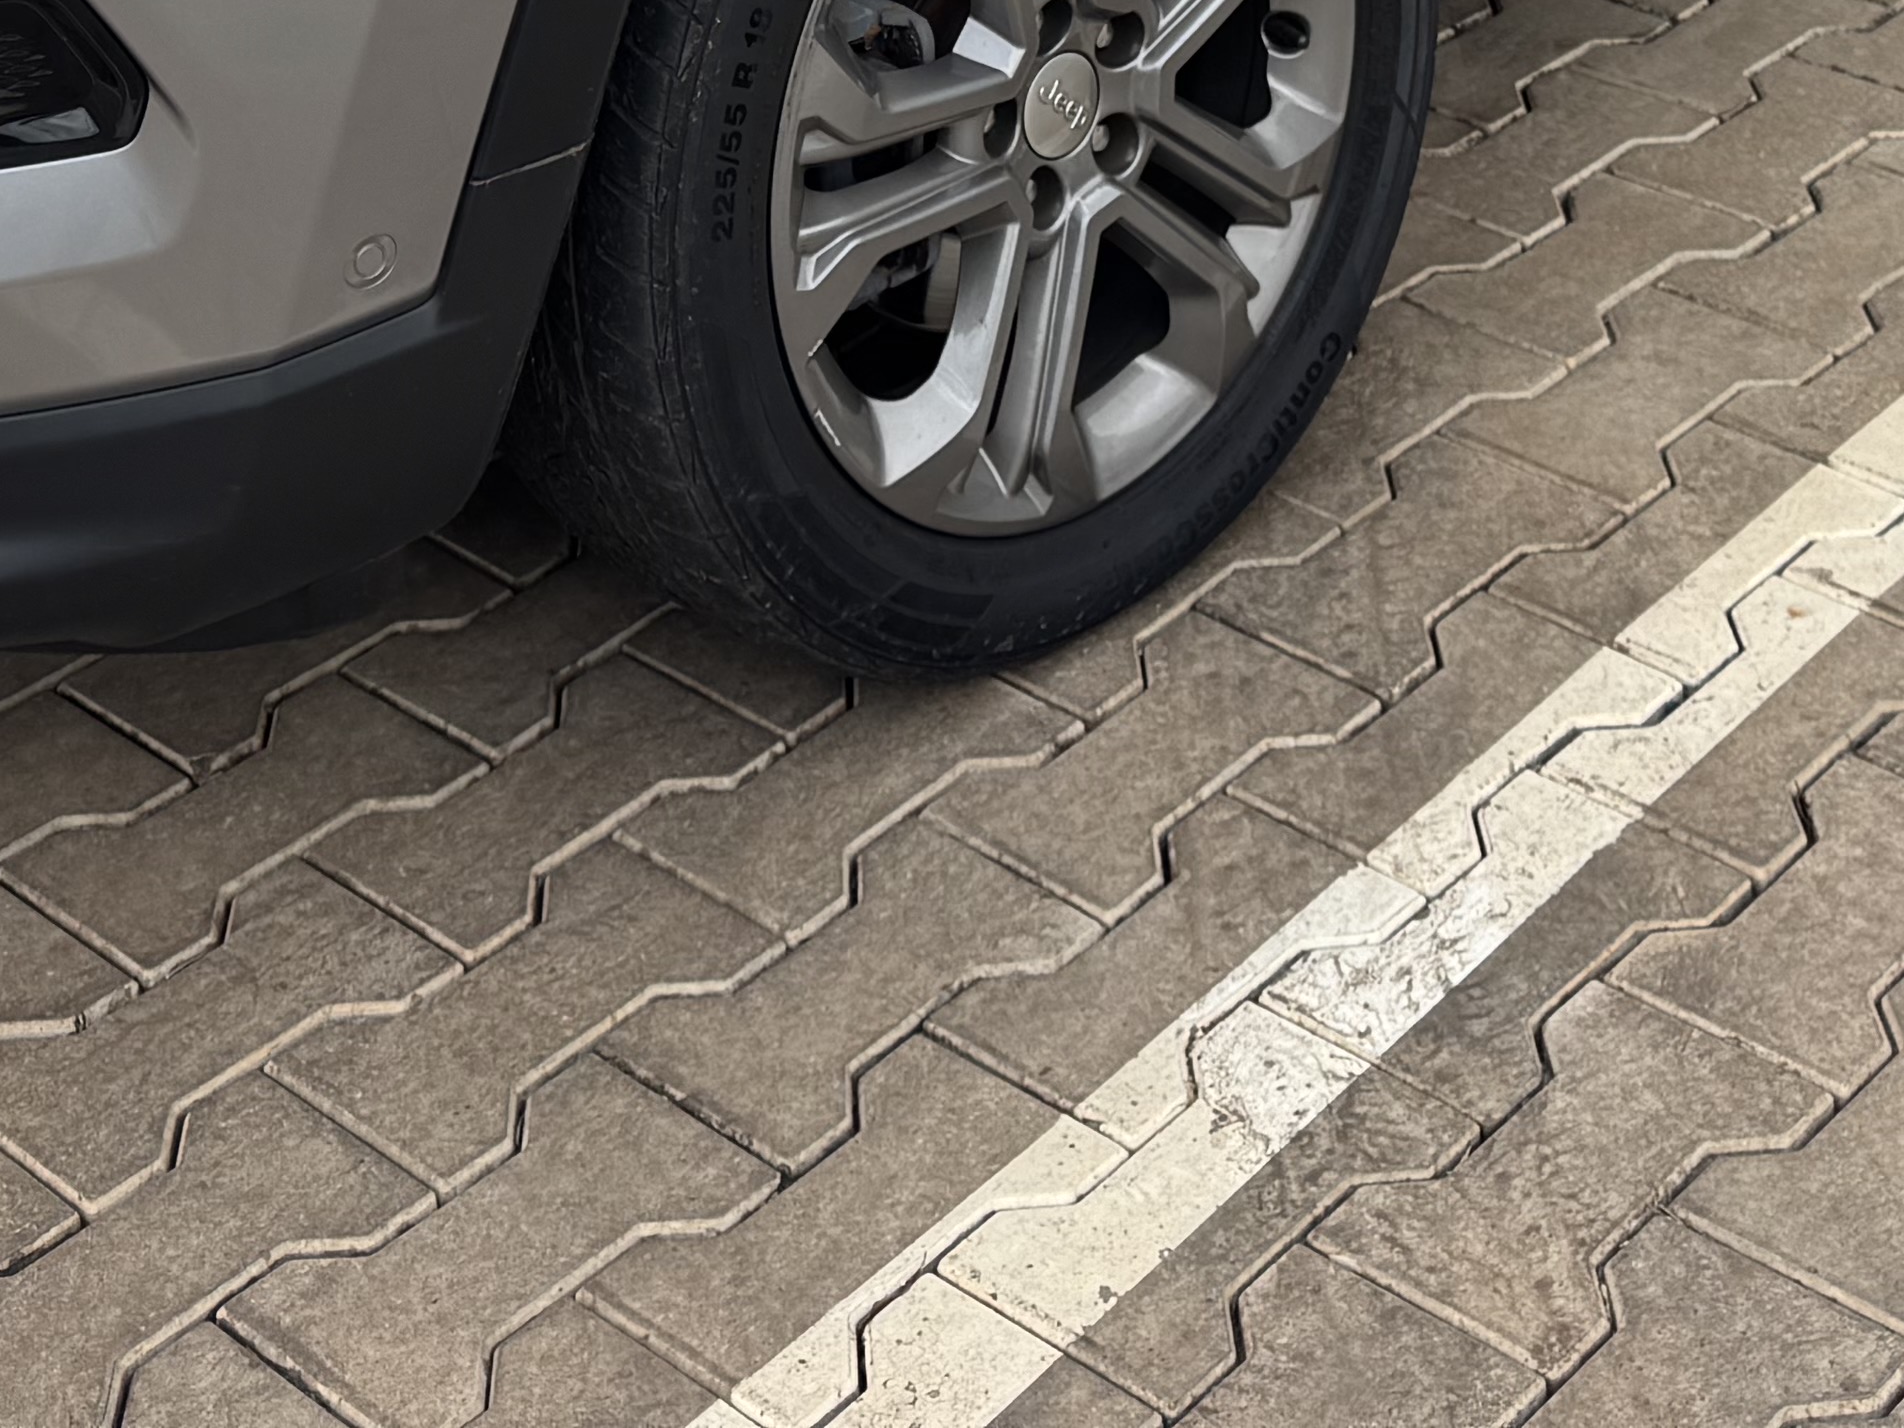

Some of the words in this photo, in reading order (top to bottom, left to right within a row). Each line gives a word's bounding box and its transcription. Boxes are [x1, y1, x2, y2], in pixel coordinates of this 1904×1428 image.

[710, 102, 748, 244] 225/55
[731, 61, 758, 90] R
[1038, 78, 1087, 130] Jeep
